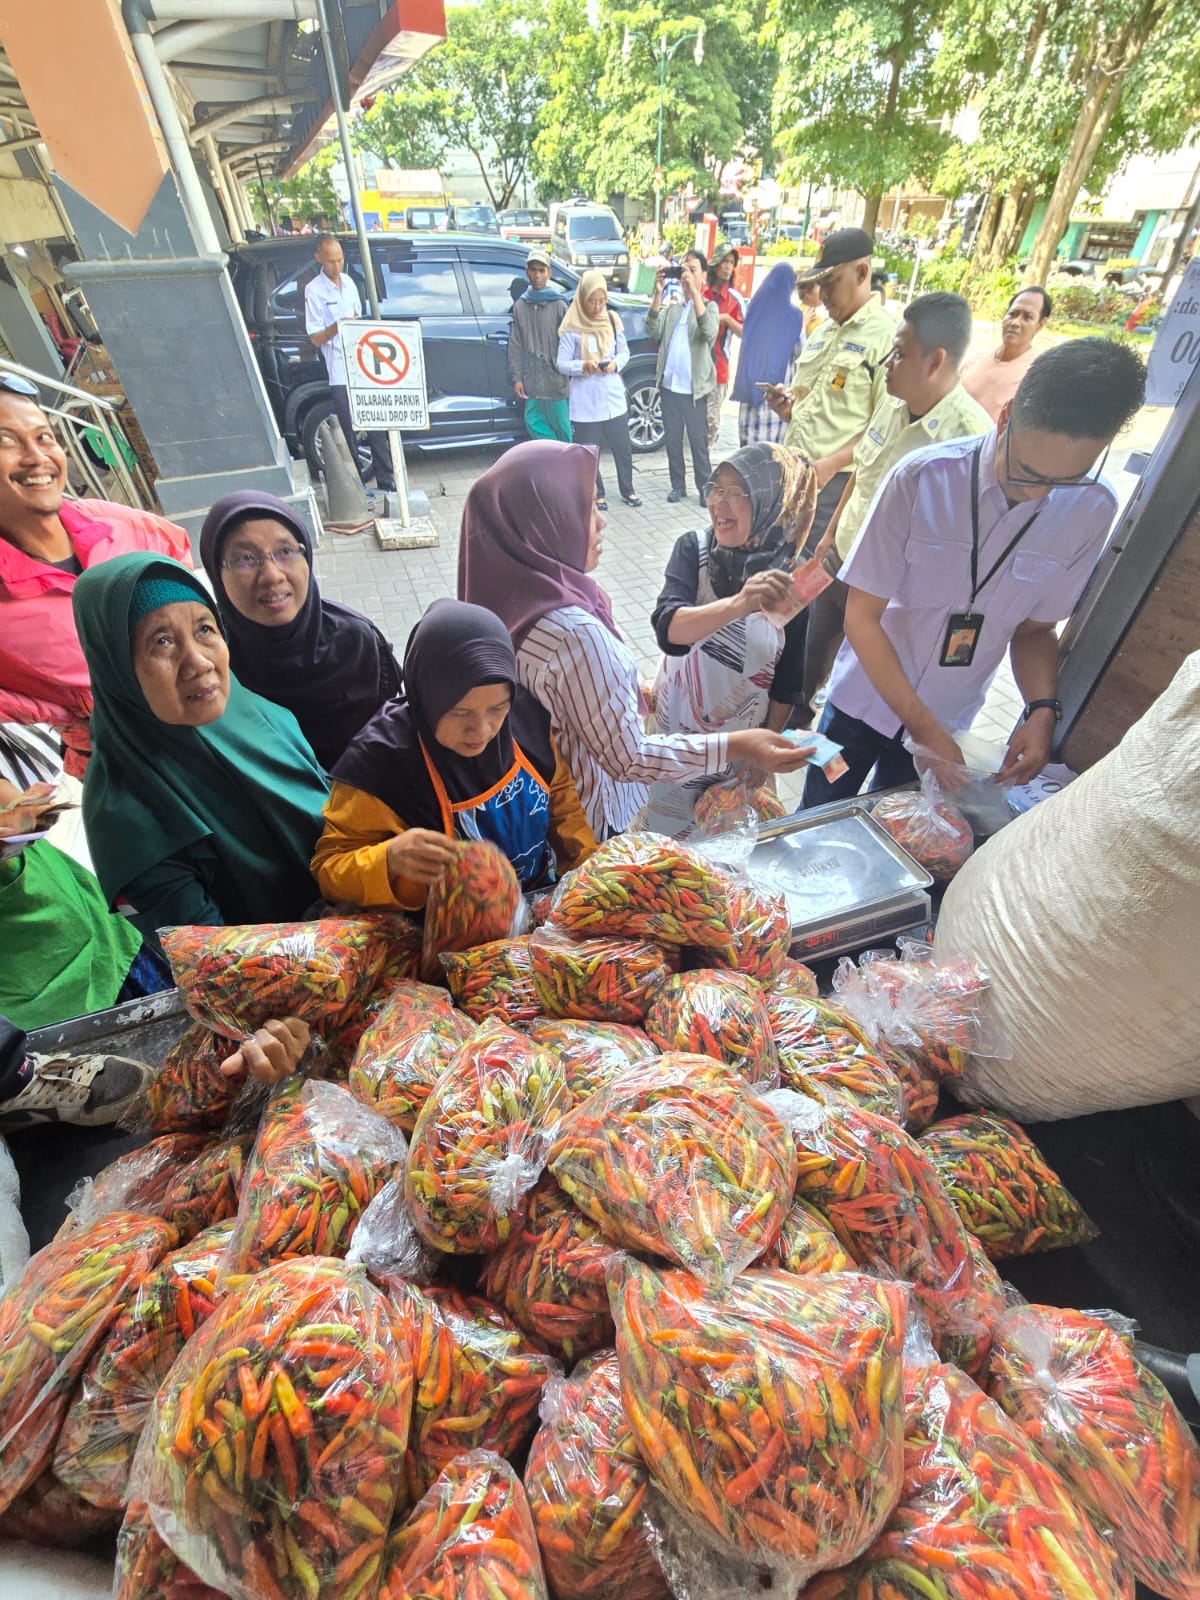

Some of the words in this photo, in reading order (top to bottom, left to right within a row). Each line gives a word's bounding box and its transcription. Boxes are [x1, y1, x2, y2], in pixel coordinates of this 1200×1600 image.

[356, 395, 392, 406] DILARANG
[394, 395, 420, 406] PARKIR
[356, 410, 387, 422] KECUALI
[389, 411, 408, 422] DROP
[410, 411, 423, 422] OFF
